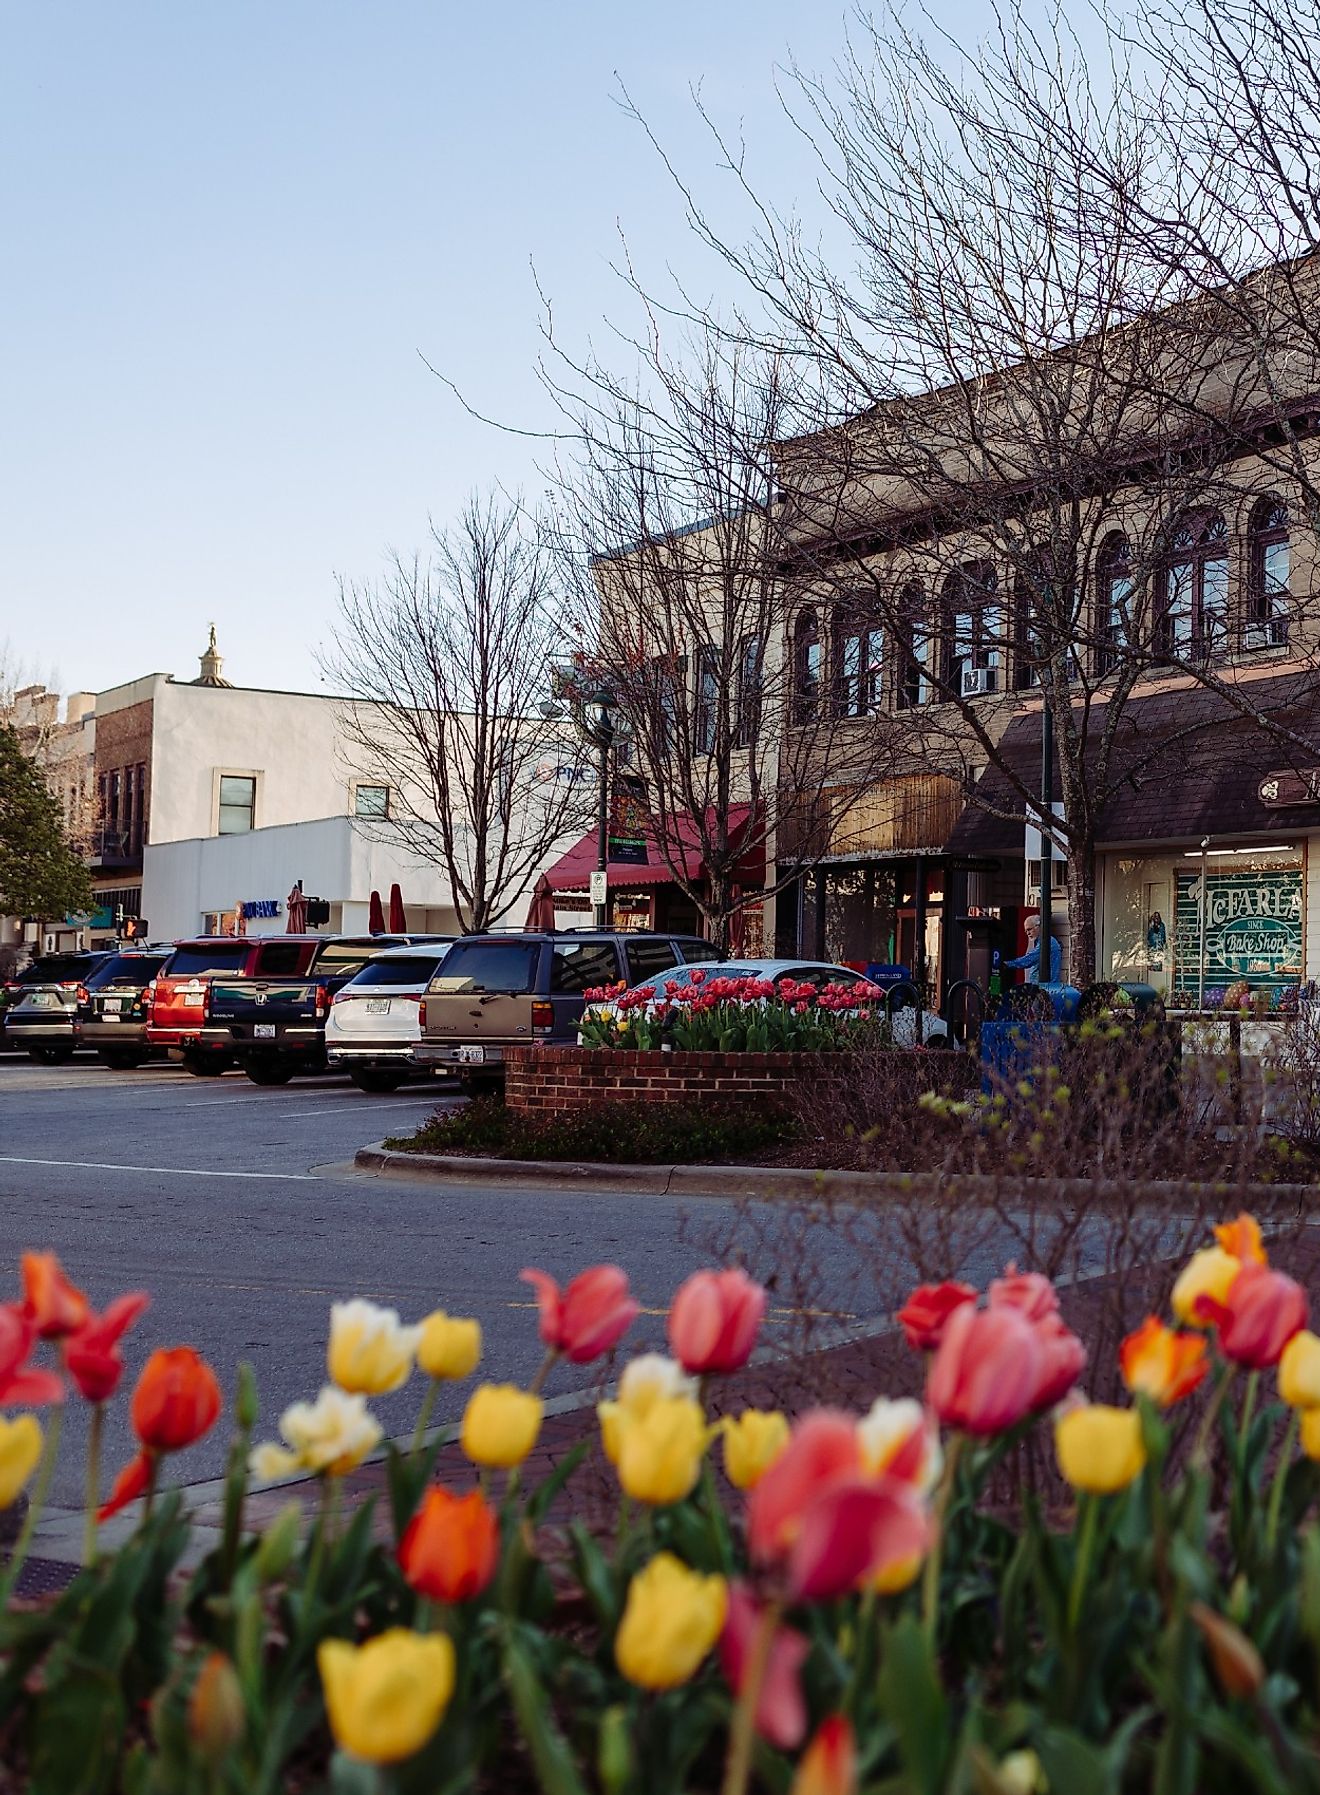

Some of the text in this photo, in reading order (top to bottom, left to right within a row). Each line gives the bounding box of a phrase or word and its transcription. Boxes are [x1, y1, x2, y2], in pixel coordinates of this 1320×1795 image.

[1247, 920, 1264, 930] SINCE
[1226, 932, 1286, 954] Bake Shop
